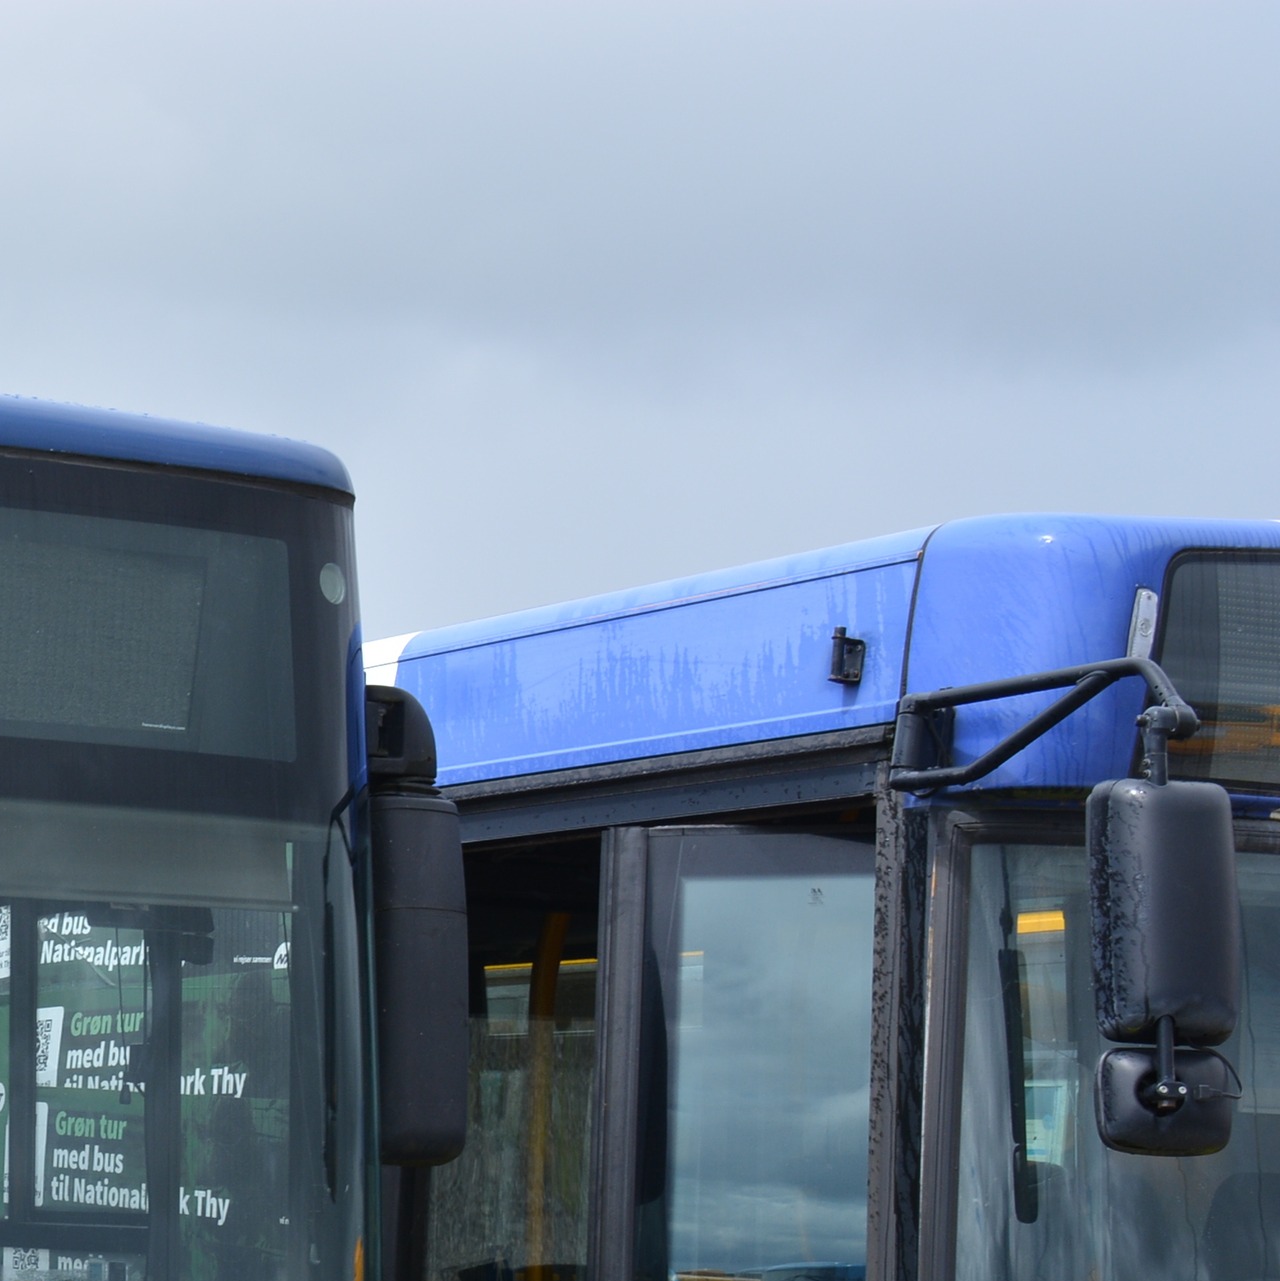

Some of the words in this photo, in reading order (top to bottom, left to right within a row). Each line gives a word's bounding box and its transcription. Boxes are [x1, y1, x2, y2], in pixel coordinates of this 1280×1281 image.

[61, 912, 91, 935] bus
[70, 1012, 112, 1037] Grøn
[65, 1040, 106, 1070] med
[210, 1066, 247, 1098] Thy
[55, 1110, 95, 1138] Grøn
[100, 1114, 127, 1140] tur
[53, 1144, 90, 1171] med
[92, 1145, 124, 1174] bus
[51, 1174, 69, 1202] til
[194, 1189, 230, 1226] Thy
